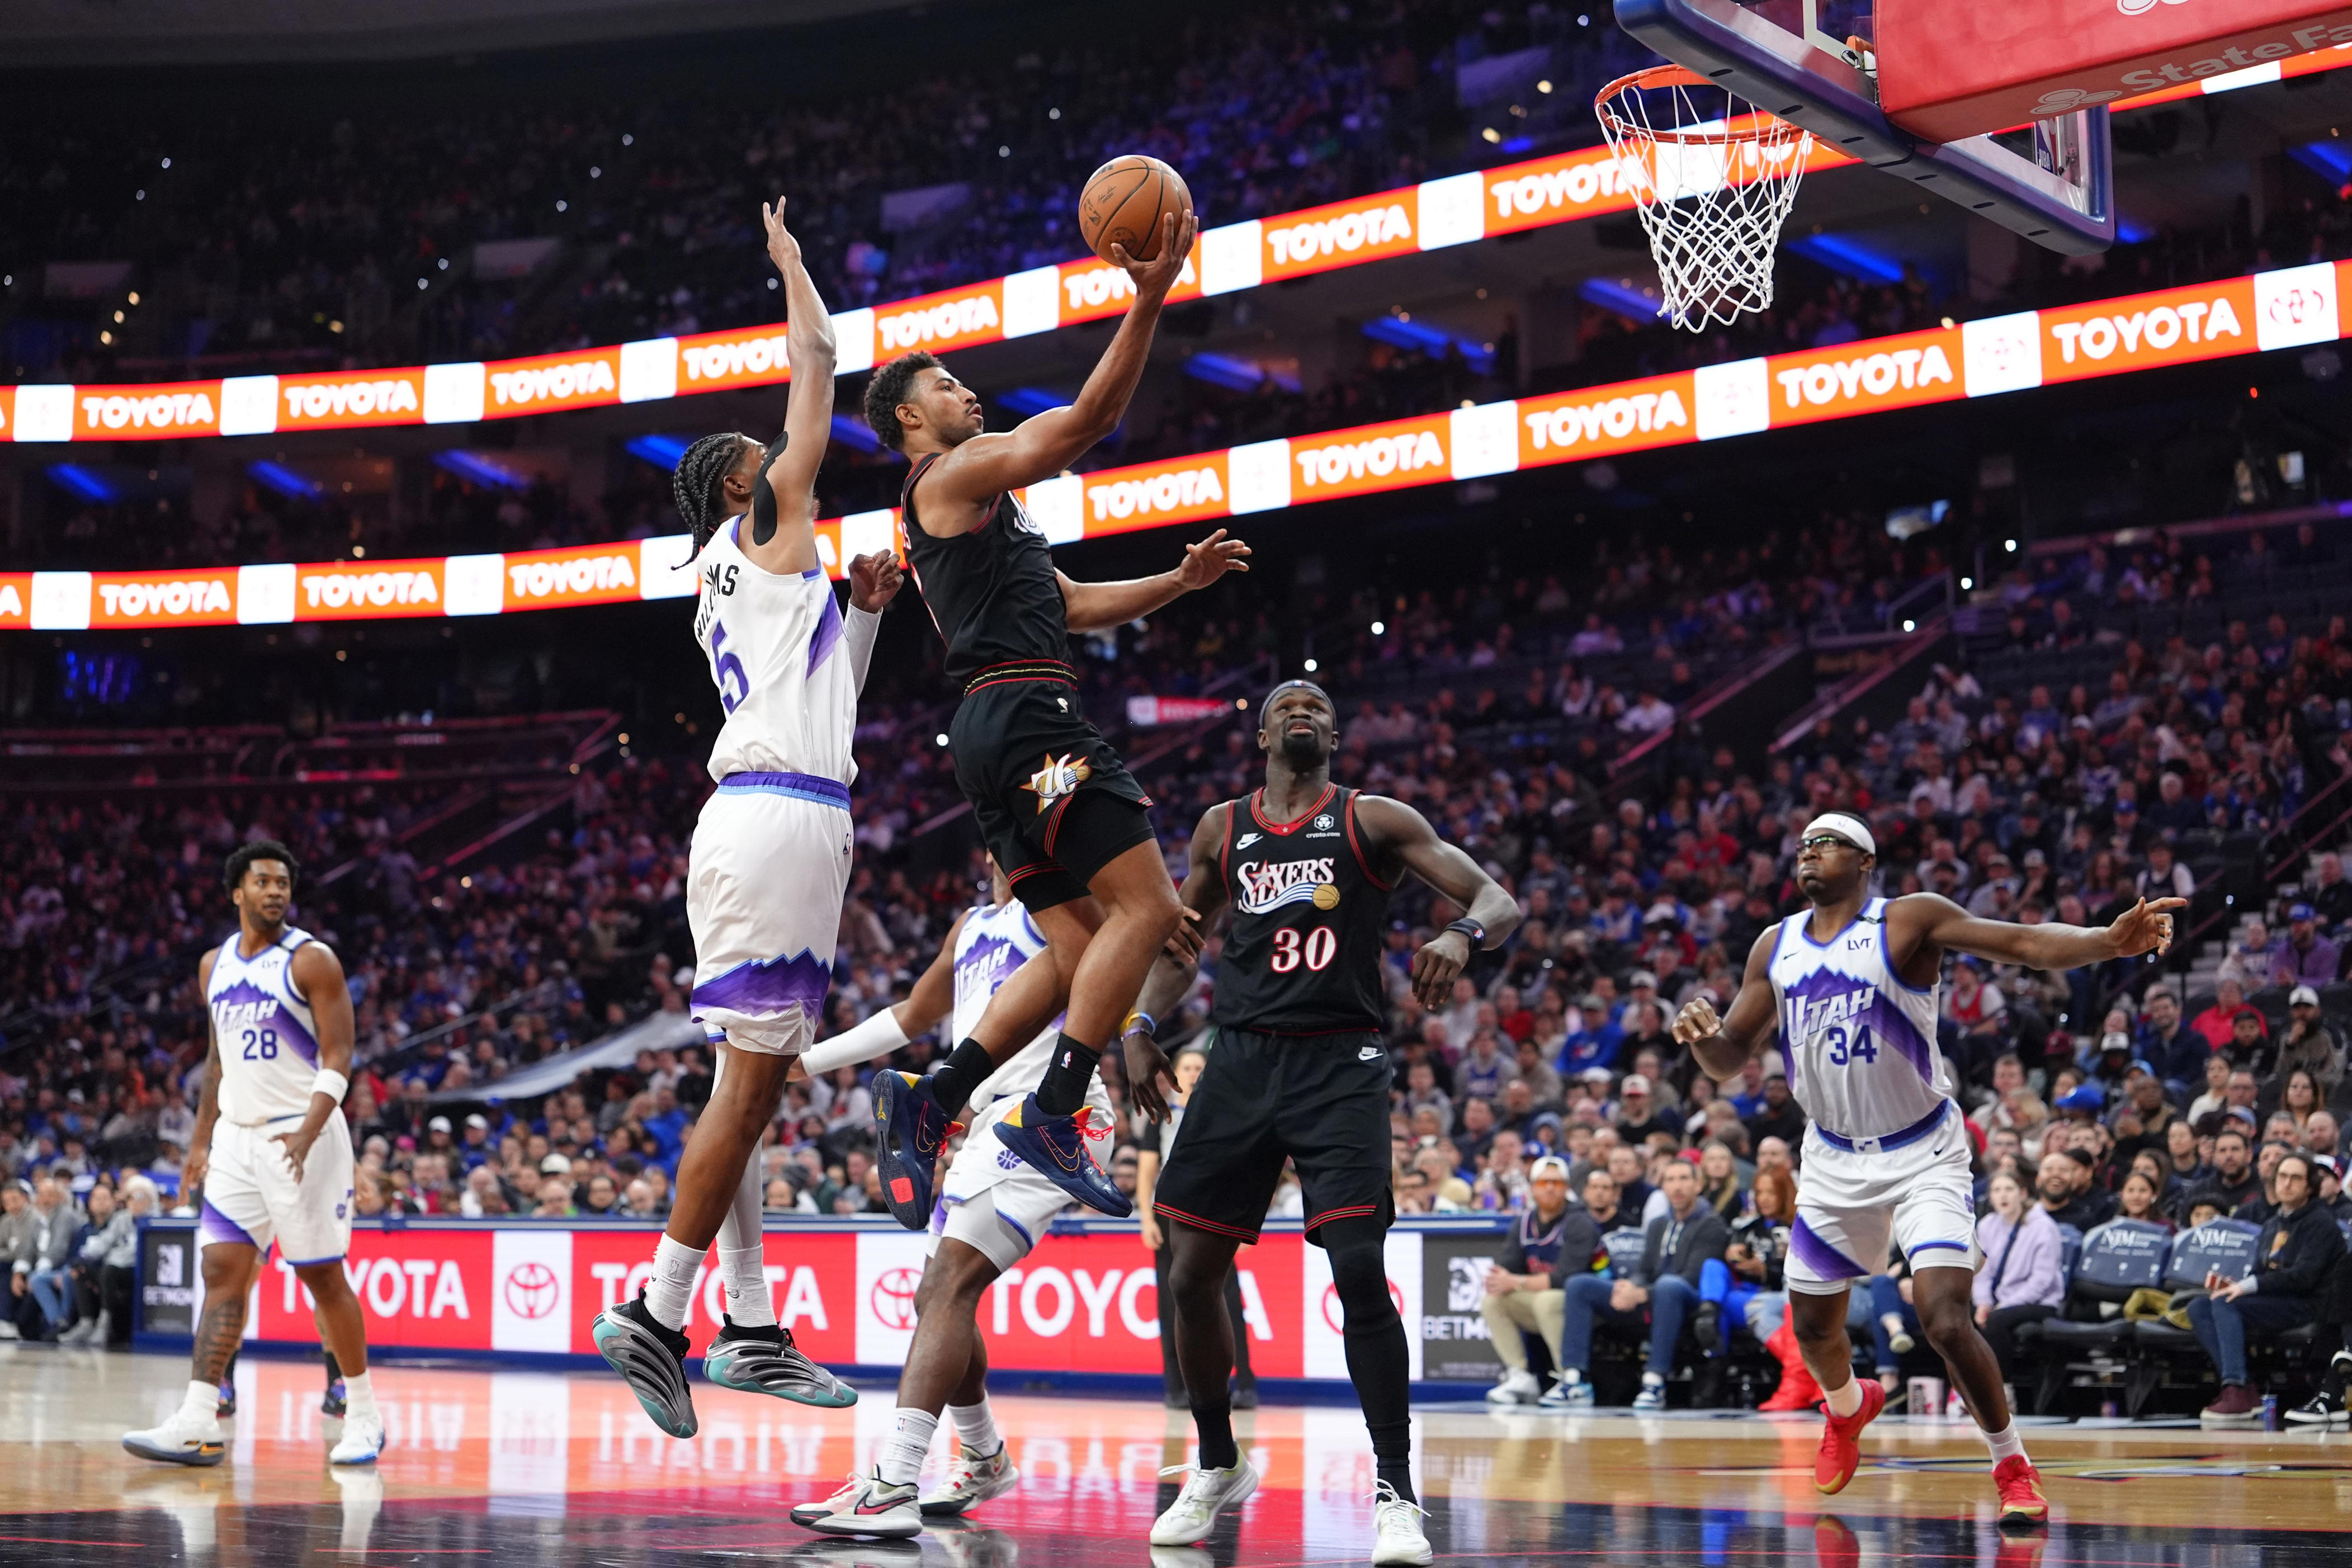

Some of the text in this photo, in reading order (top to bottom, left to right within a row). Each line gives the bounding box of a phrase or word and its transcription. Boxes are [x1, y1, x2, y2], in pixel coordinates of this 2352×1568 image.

[1491, 154, 1647, 218] TOYOTA
[1267, 204, 1412, 265] TOYOTA
[1064, 255, 1196, 309] TOYA
[877, 295, 999, 350] TOYOTA
[2052, 297, 2241, 363] TOYOTA
[490, 360, 615, 405] TOYOTA
[682, 335, 790, 380] TOYOT
[1777, 345, 1953, 408] TOYOTA
[82, 393, 214, 429] TOYOTA
[284, 380, 418, 418] TOYOTA
[1525, 390, 1687, 450] TOYOTA
[1296, 431, 1444, 486] TOYOTA
[1087, 467, 1224, 521] TOYOTA
[99, 580, 230, 616] TOYOTA
[302, 572, 438, 608] TOYOTA
[509, 555, 635, 597] TOYOTA
[711, 618, 750, 716] 5
[1271, 925, 1337, 973] 30
[1848, 938, 1872, 950] LVT
[211, 999, 279, 1033] UTAH
[1786, 985, 1878, 1047] UTAH
[242, 1029, 278, 1060] 28
[1828, 1024, 1877, 1066] 34
[275, 1256, 470, 1320] TYOTA
[992, 1265, 1273, 1340] TOYOA
[1423, 1315, 1493, 1340] BETM
